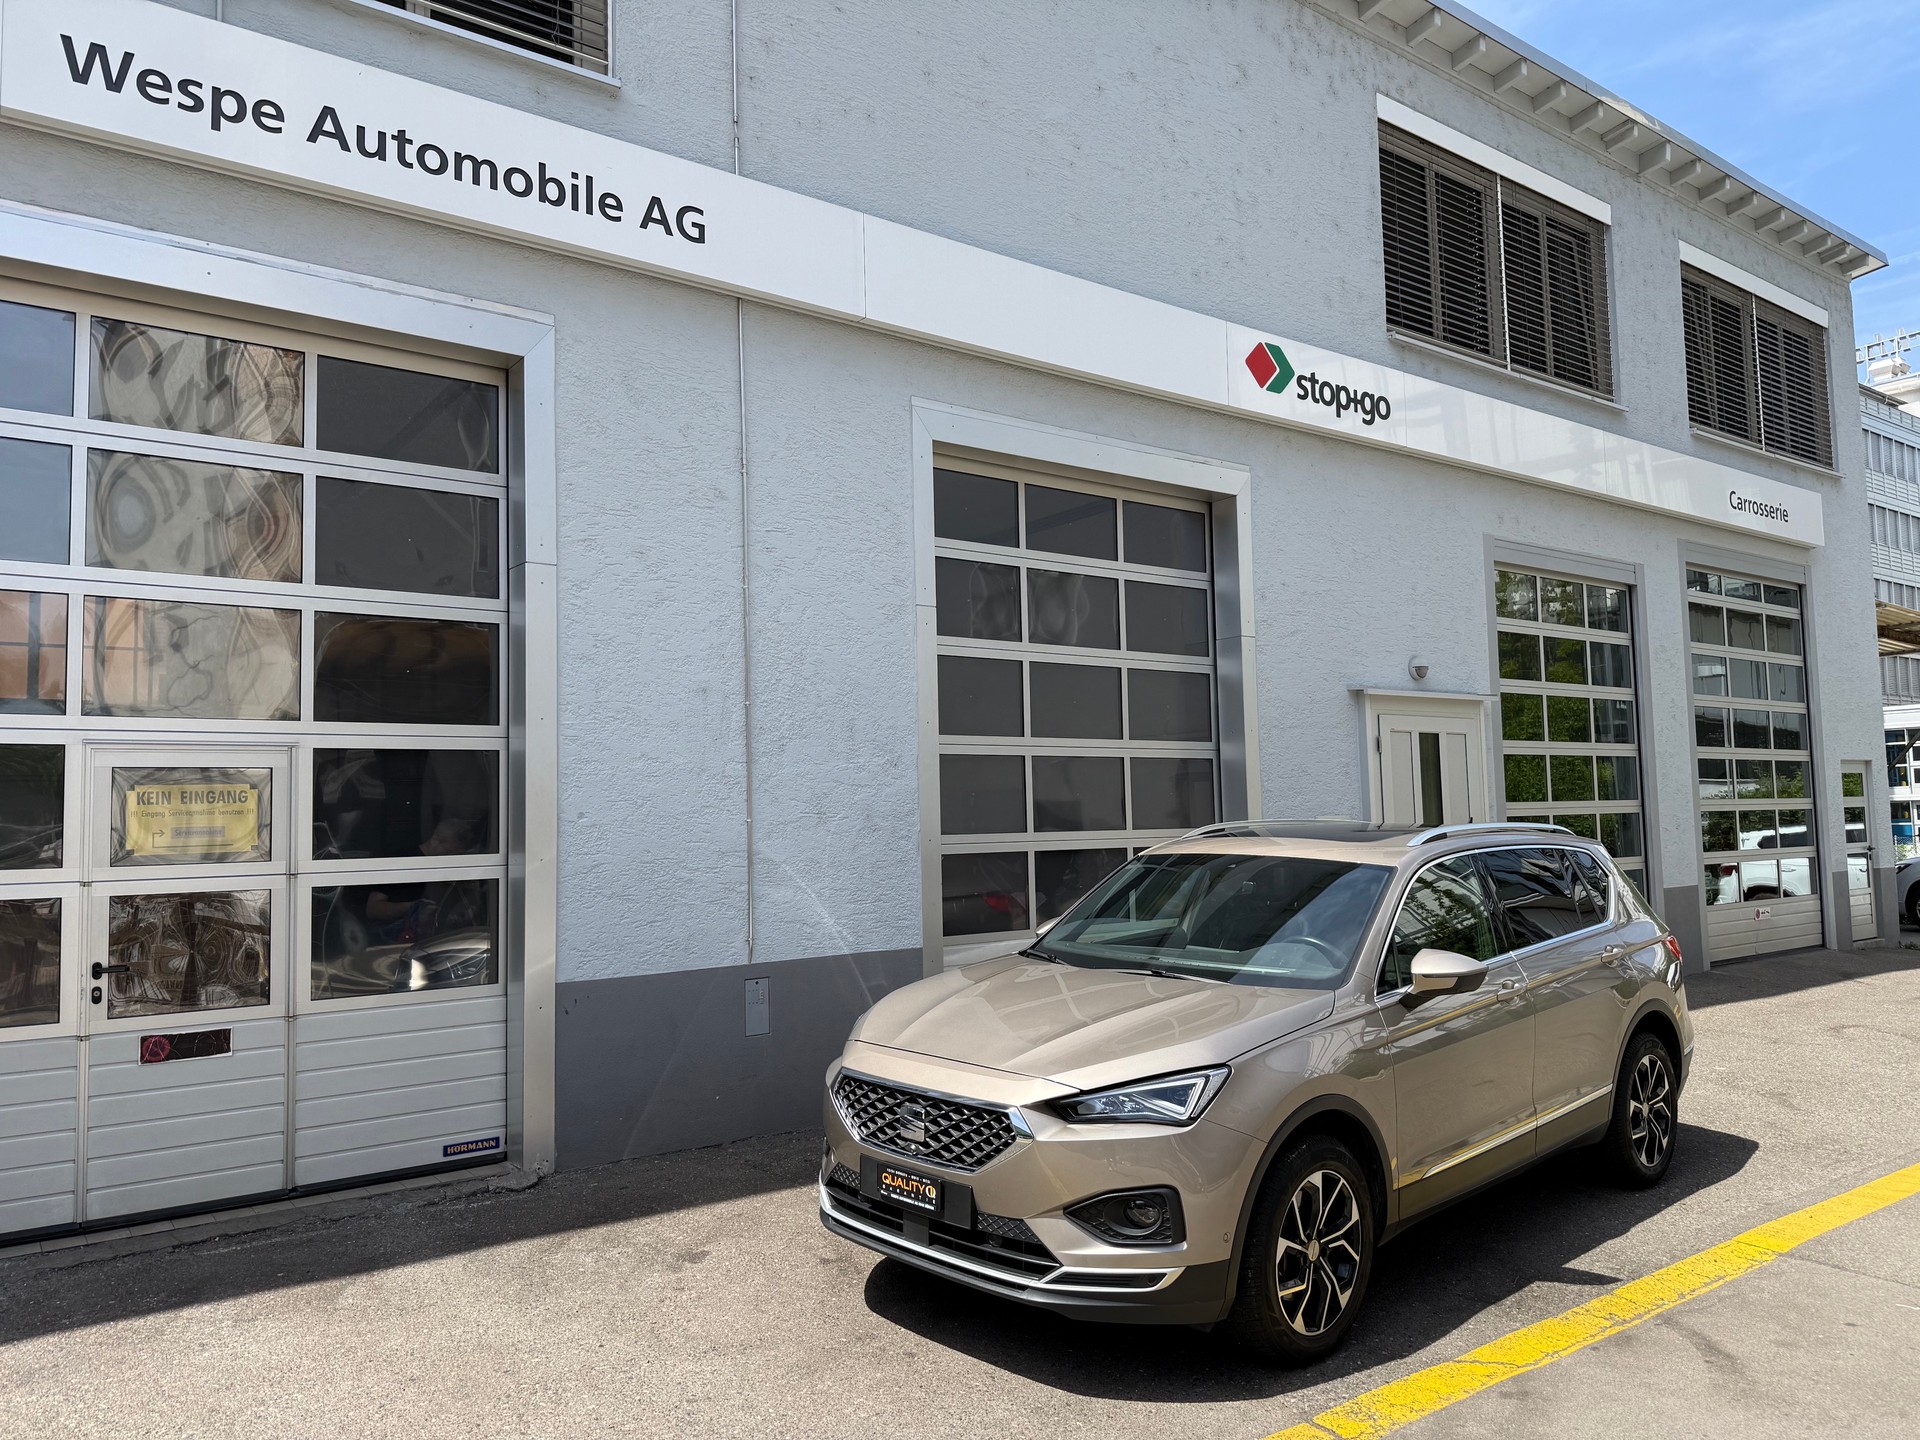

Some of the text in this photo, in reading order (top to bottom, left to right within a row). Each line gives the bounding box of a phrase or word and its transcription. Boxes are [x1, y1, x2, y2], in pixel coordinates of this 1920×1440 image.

[60, 33, 707, 245] Wespe Automobile AG
[1296, 372, 1391, 425] stop+go
[1729, 490, 1789, 523] Carrosserie
[136, 790, 249, 805] KEIN EINGANG
[141, 810, 166, 818] Eingang
[218, 808, 244, 816] benutzen
